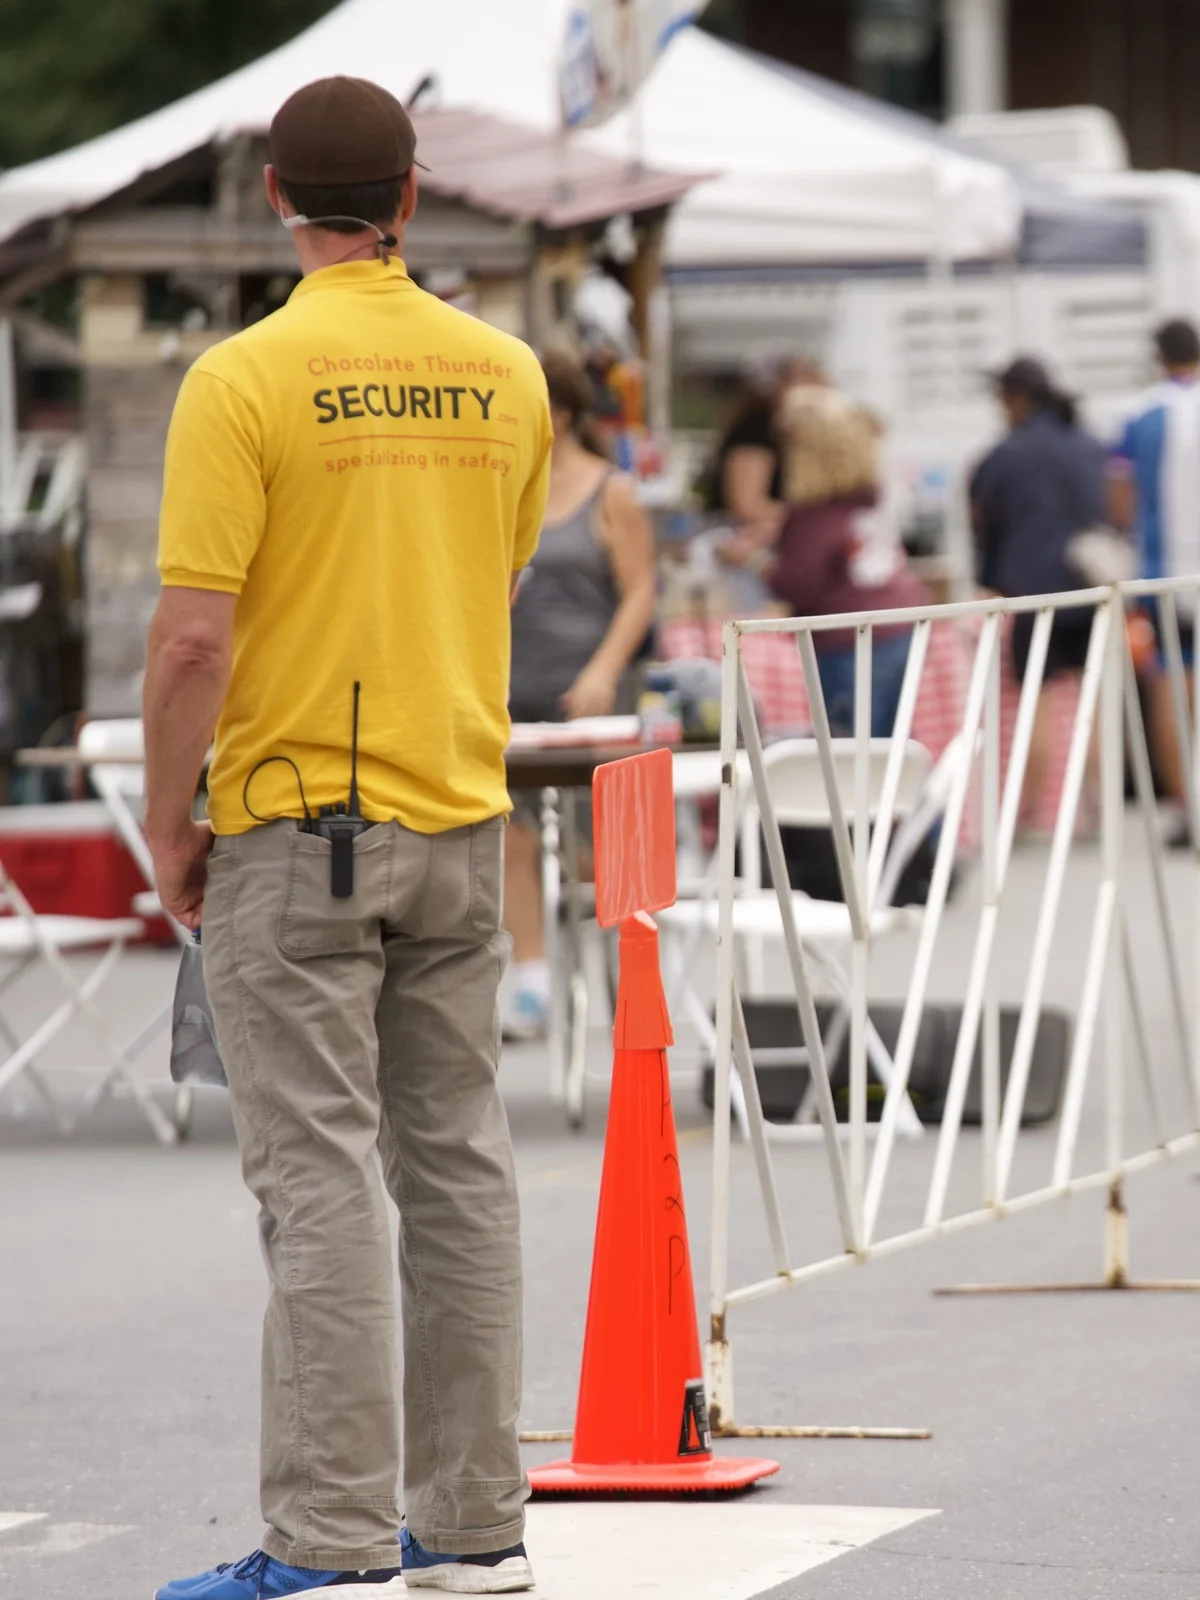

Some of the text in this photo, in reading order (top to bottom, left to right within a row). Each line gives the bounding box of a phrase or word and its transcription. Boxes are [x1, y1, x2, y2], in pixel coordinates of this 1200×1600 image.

[308, 353, 512, 379] Chocolate Thunder
[313, 383, 496, 424] SECURITY
[325, 449, 512, 477] specializing in safety
